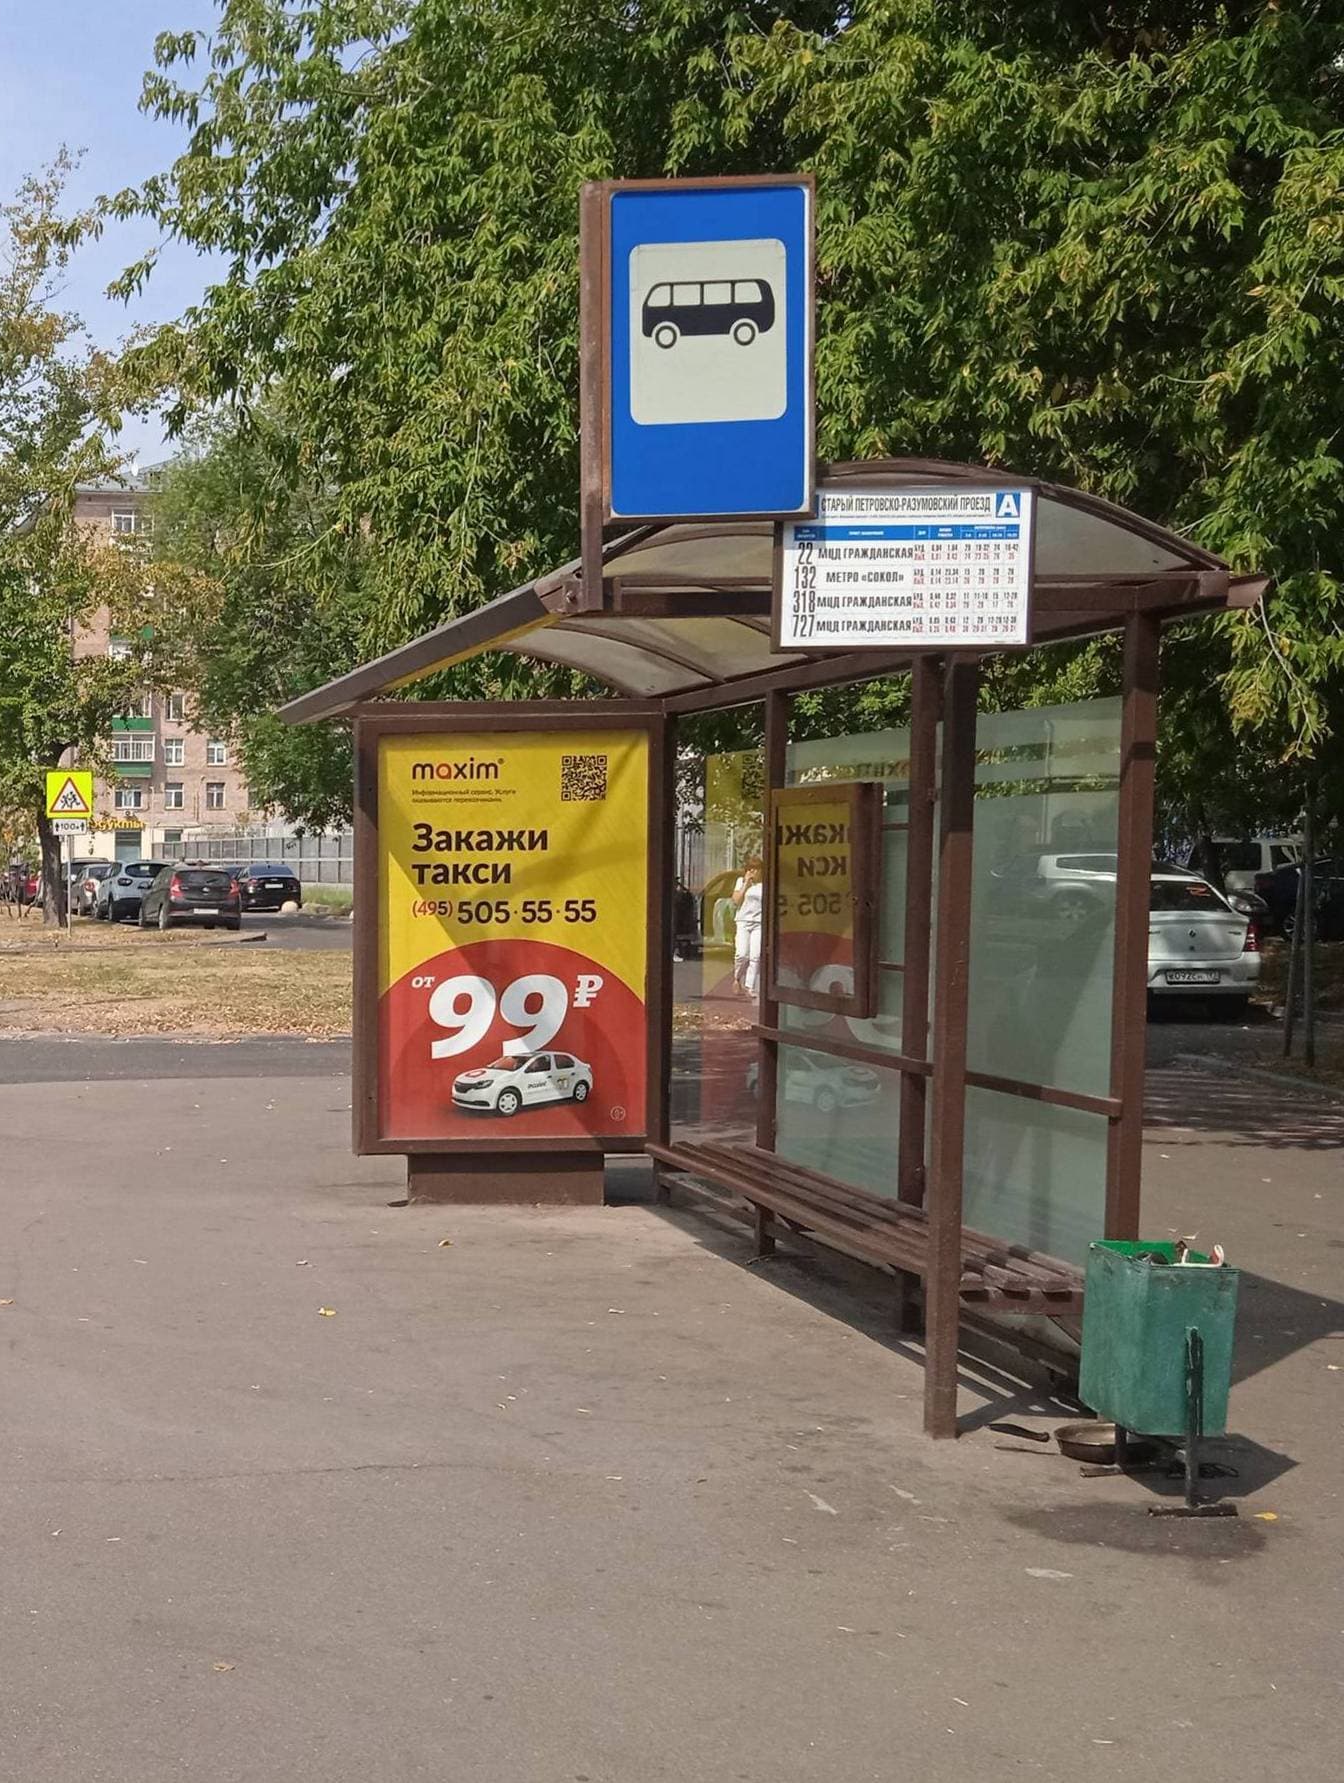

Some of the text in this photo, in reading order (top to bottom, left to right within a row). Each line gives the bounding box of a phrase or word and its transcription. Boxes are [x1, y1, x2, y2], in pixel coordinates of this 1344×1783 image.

[821, 494, 991, 512] СТАРЫЙ ПЕТРОВСКО-РАЗУМОВСКИЙ ПРОЕЗД
[798, 542, 813, 564] 22
[818, 548, 841, 560] МЦД
[843, 548, 913, 560] ГРАЖДАНСКАЯ
[794, 565, 816, 589] 132
[826, 572, 859, 582] МЕТРО
[861, 572, 904, 582] «СОКОЛ»
[793, 590, 816, 613] 318
[817, 596, 840, 608] МЦД
[841, 596, 912, 608] ГРАЖДАНСКАЯ
[793, 614, 815, 637] 727
[816, 620, 839, 632] МЦД
[841, 620, 911, 632] ГРАЖДАНСКАЯ
[412, 823, 548, 851] Закажи
[412, 863, 511, 884] такси
[412, 901, 453, 918] (495)
[411, 976, 436, 988] от
